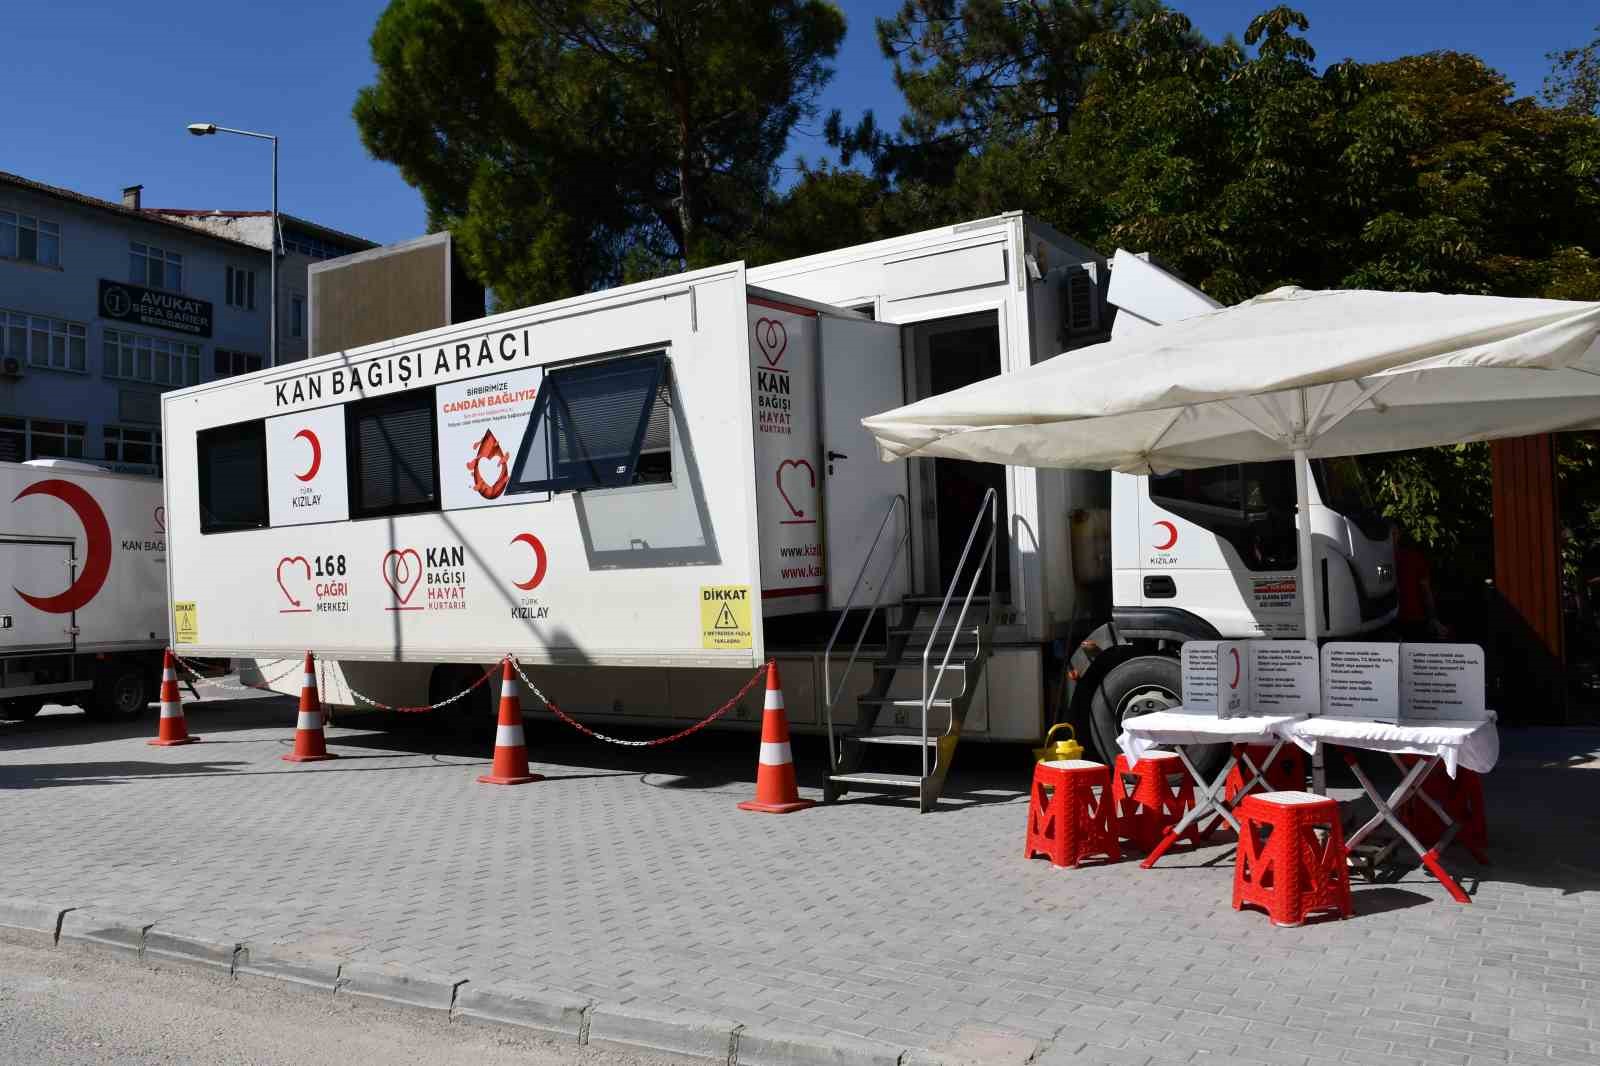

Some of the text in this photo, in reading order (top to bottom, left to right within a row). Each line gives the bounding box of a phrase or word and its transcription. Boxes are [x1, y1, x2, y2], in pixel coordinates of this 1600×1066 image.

[141, 291, 201, 313] AVUKAT
[275, 330, 530, 406] KAN BAĞIŞI ARACI
[758, 371, 790, 395] KAN
[443, 397, 486, 413] CANDAN
[487, 389, 537, 406] BAĞLIYIZ
[759, 395, 791, 413] BAĞIŞI
[759, 410, 791, 424] HAYAT
[121, 540, 142, 551] KAN
[315, 554, 346, 577] 168
[426, 545, 464, 568] KAN
[427, 569, 465, 586] BAĞIŞI
[315, 579, 348, 600] ÇAĞRI
[428, 586, 466, 600] HAYAT
[703, 588, 747, 600] DİKKAT
[511, 606, 549, 619] KIZILAY
